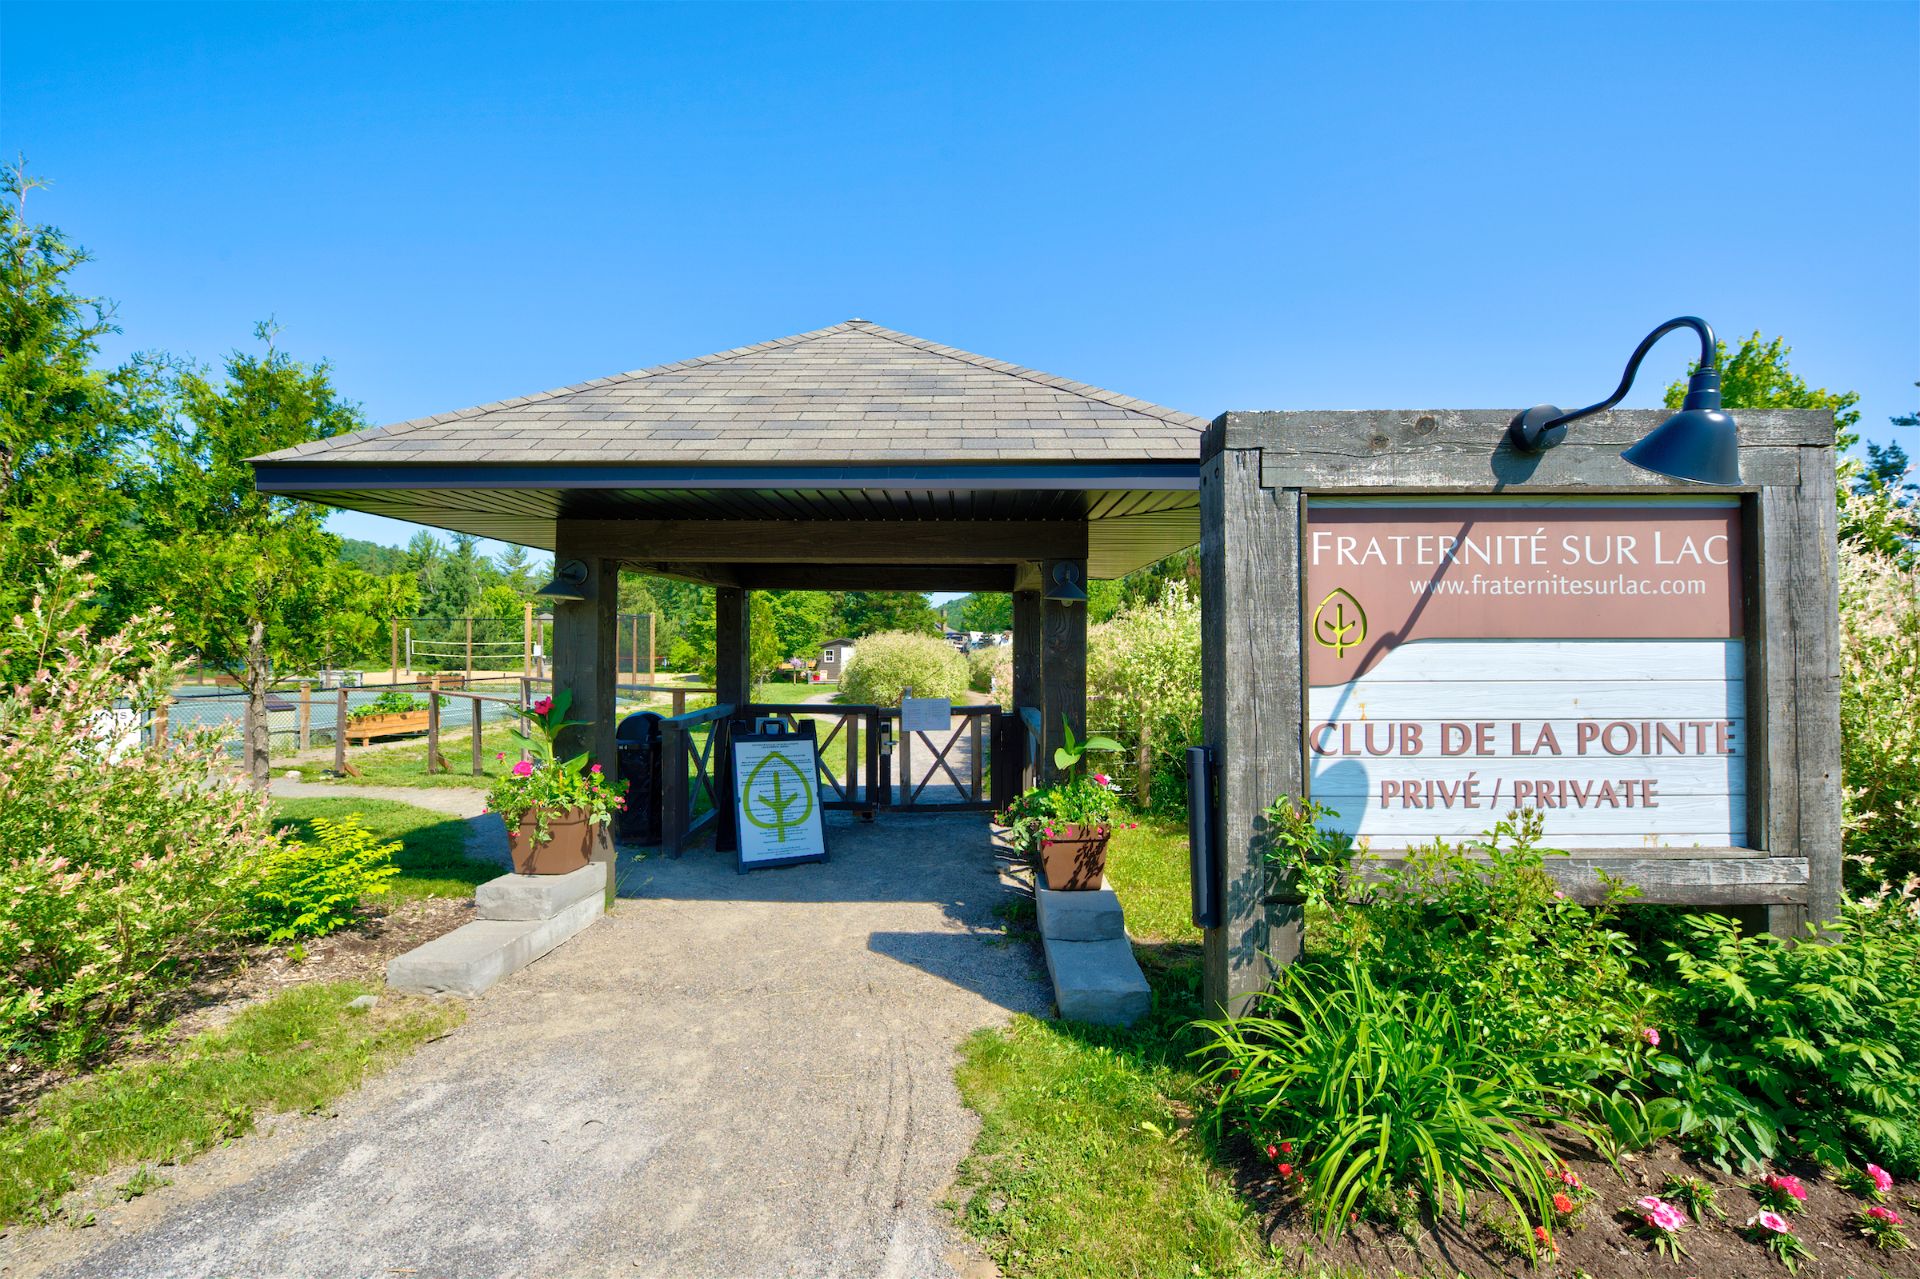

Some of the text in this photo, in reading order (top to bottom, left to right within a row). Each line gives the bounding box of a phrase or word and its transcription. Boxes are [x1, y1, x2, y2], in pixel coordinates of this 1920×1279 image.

[1312, 527, 1730, 566] FRATERNITÉ SUR LAC
[1409, 573, 1707, 596] www.fraternitesurlac.com
[1310, 720, 1736, 756] CLUB DE LA POINTE
[1381, 771, 1481, 810] PRIVÉ
[1514, 778, 1660, 809] PRIVATE
